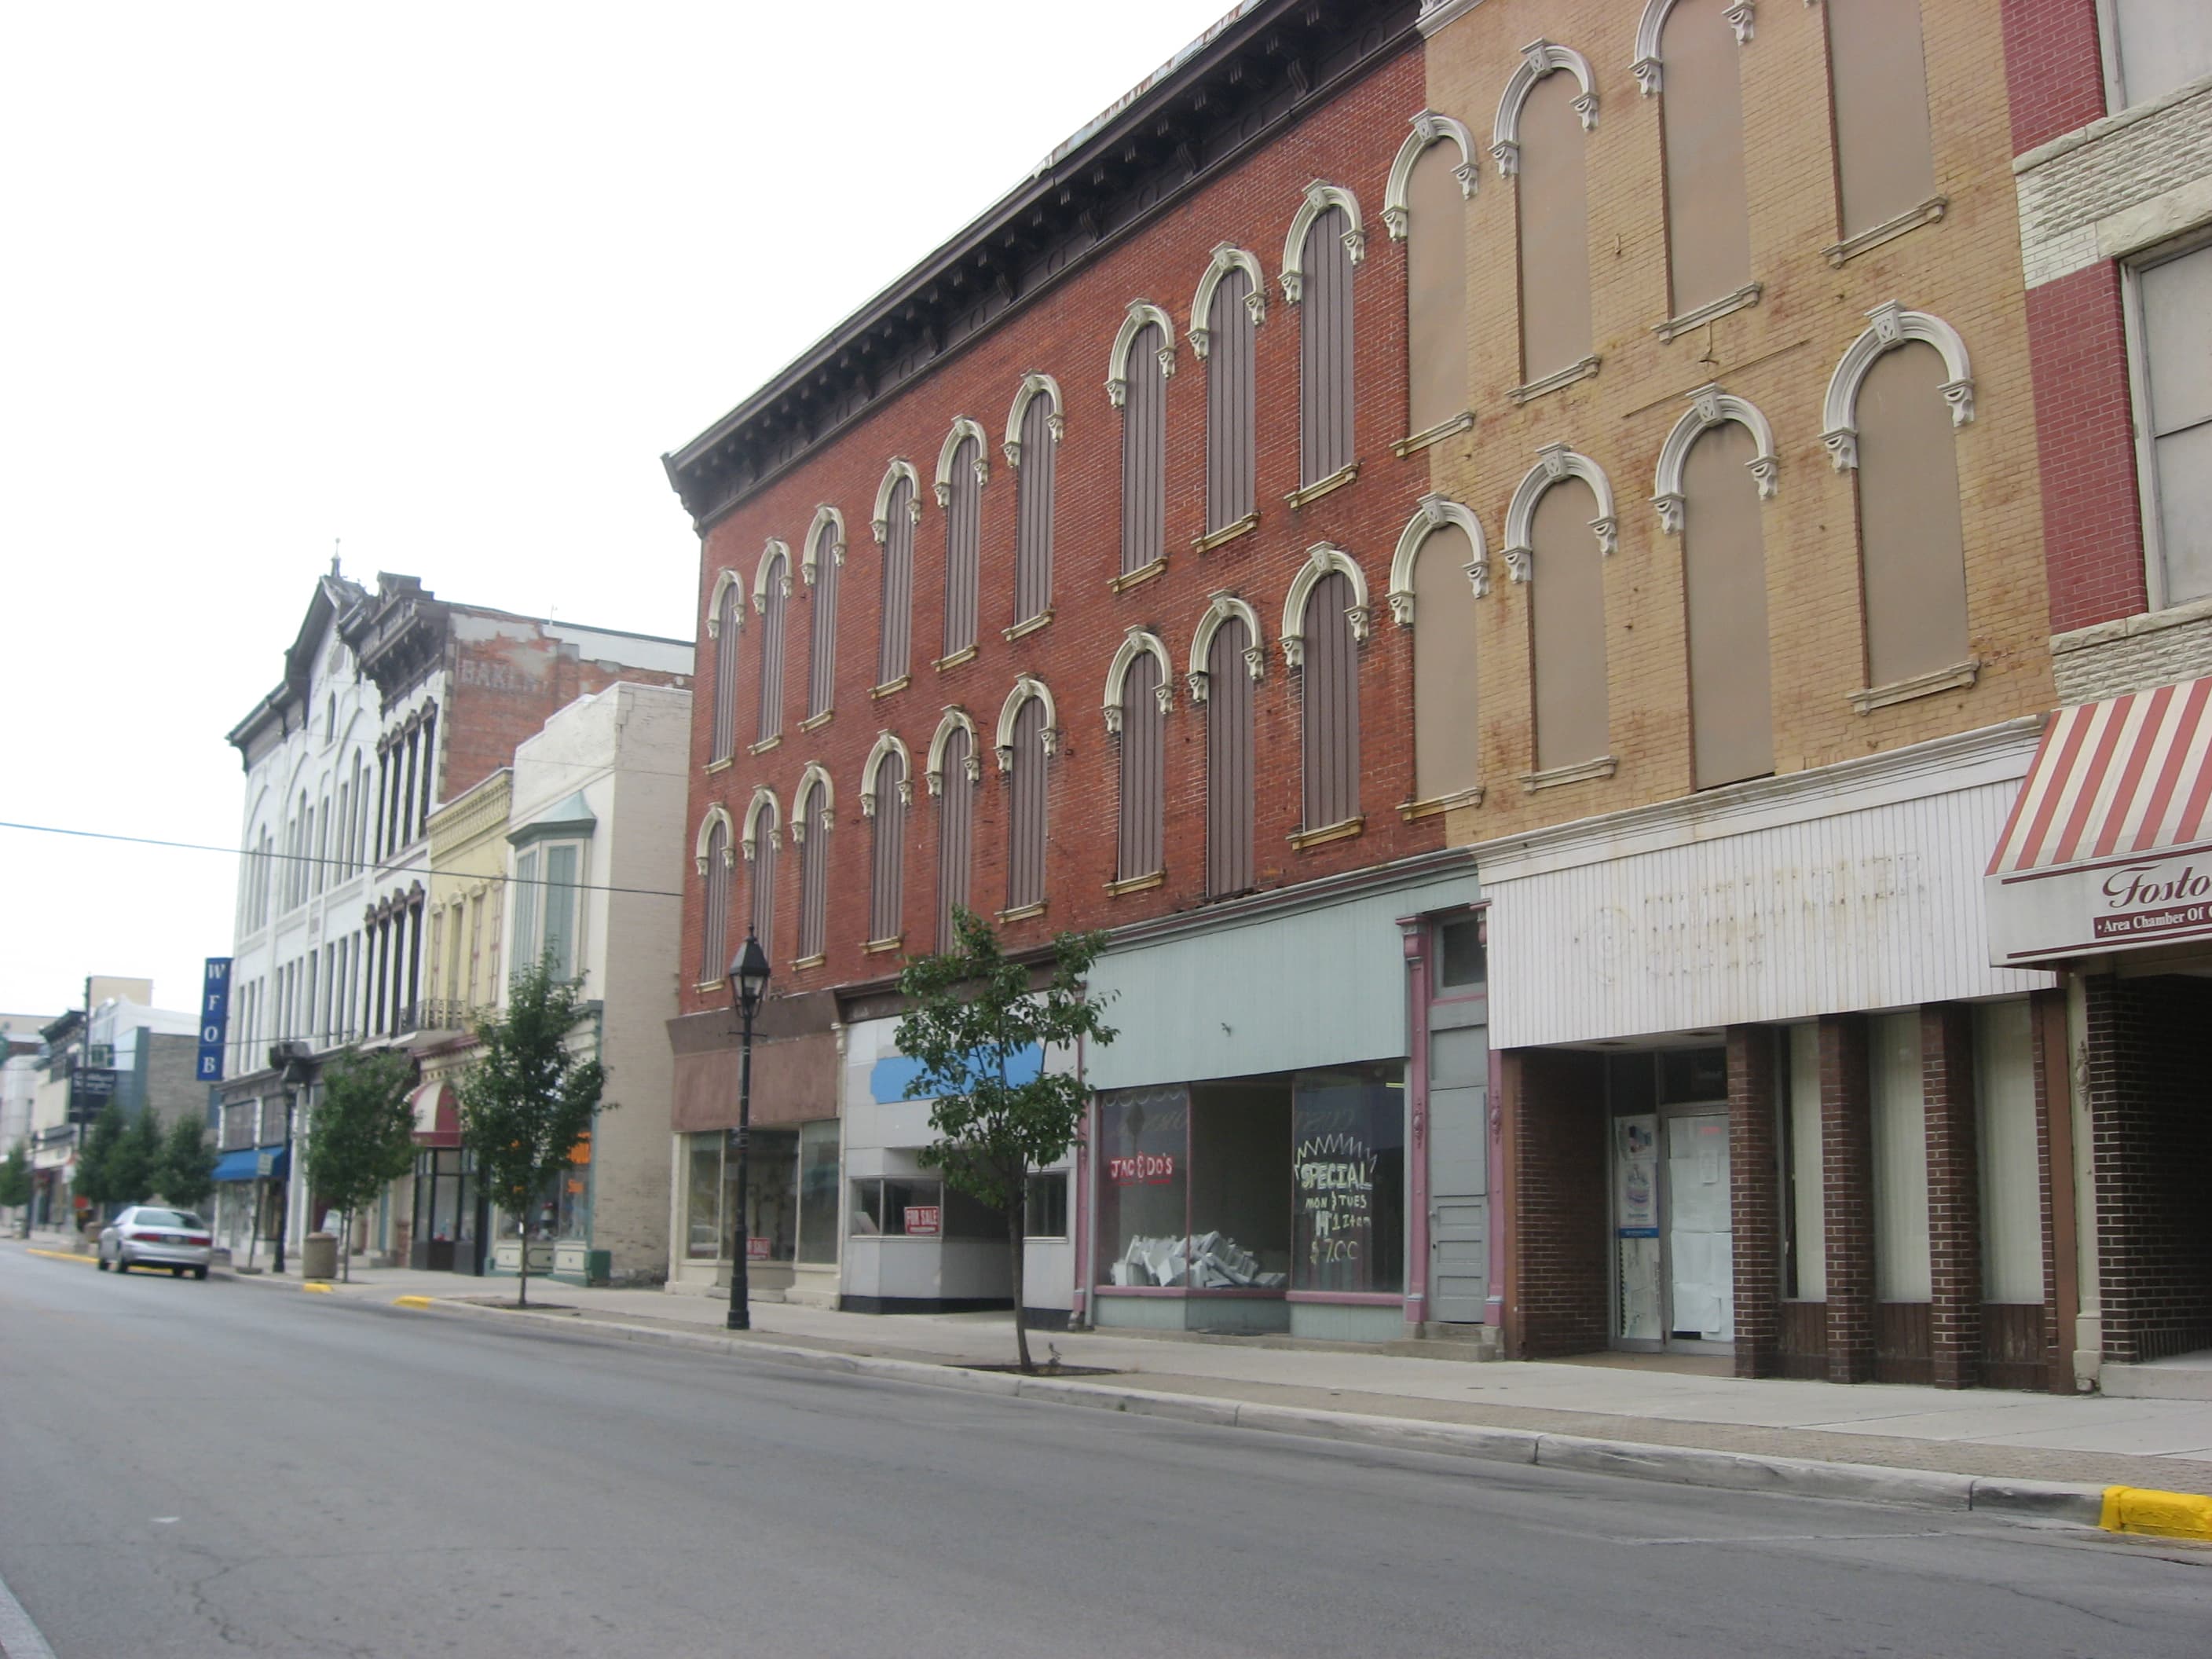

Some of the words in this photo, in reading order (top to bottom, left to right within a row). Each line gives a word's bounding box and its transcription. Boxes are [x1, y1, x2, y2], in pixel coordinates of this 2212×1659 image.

[2102, 864, 2210, 908] Fosto
[2104, 919, 2131, 932] Area
[2133, 912, 2185, 928] Chamber
[2187, 906, 2204, 921] Of
[202, 963, 226, 1074] WFOB
[1300, 1162, 1373, 1190] SPECIAL
[1306, 1196, 1328, 1208] MON
[1338, 1194, 1367, 1209] TUES
[905, 1209, 918, 1225] FOR
[920, 1208, 937, 1225] SALE
